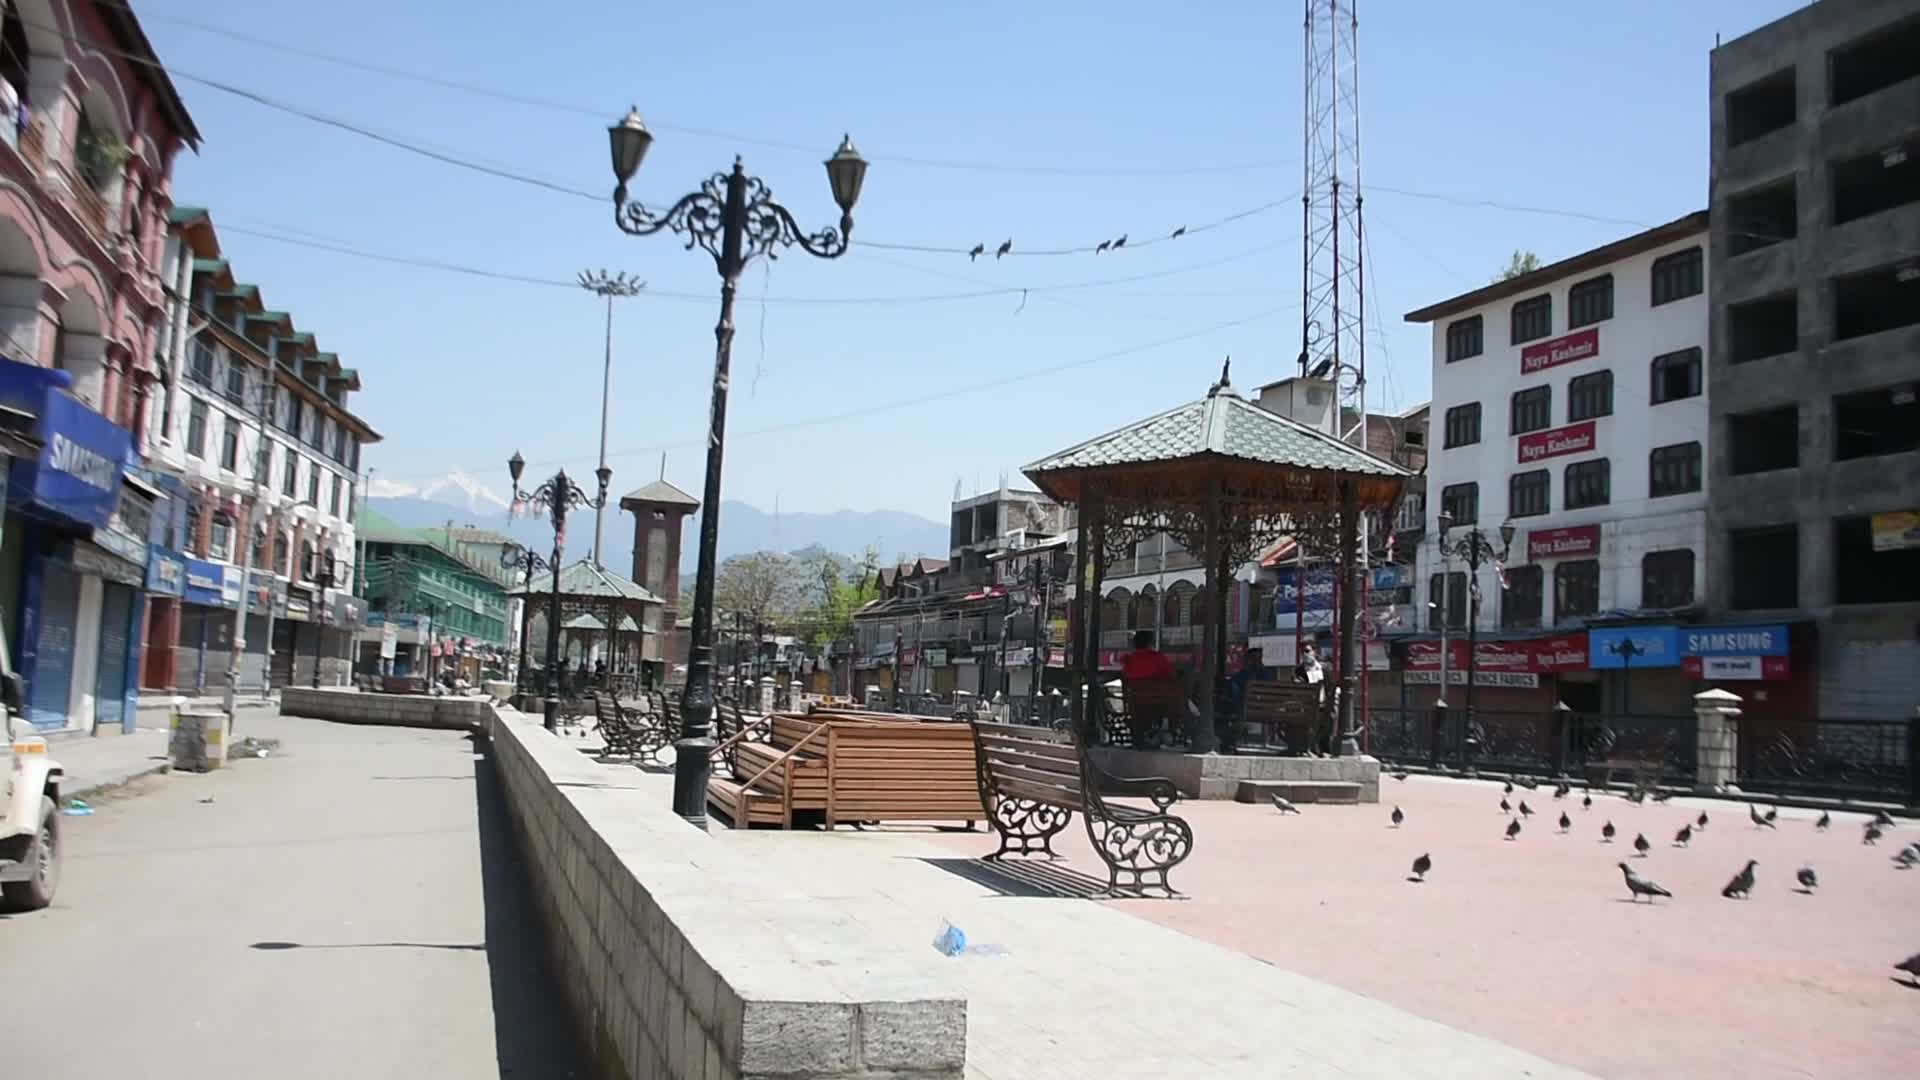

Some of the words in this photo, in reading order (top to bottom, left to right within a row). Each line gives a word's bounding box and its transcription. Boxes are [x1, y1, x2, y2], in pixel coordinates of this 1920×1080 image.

[1525, 355, 1549, 370] Naya
[1551, 341, 1593, 362] Kashmir
[1688, 632, 1771, 652] SAMSUNG
